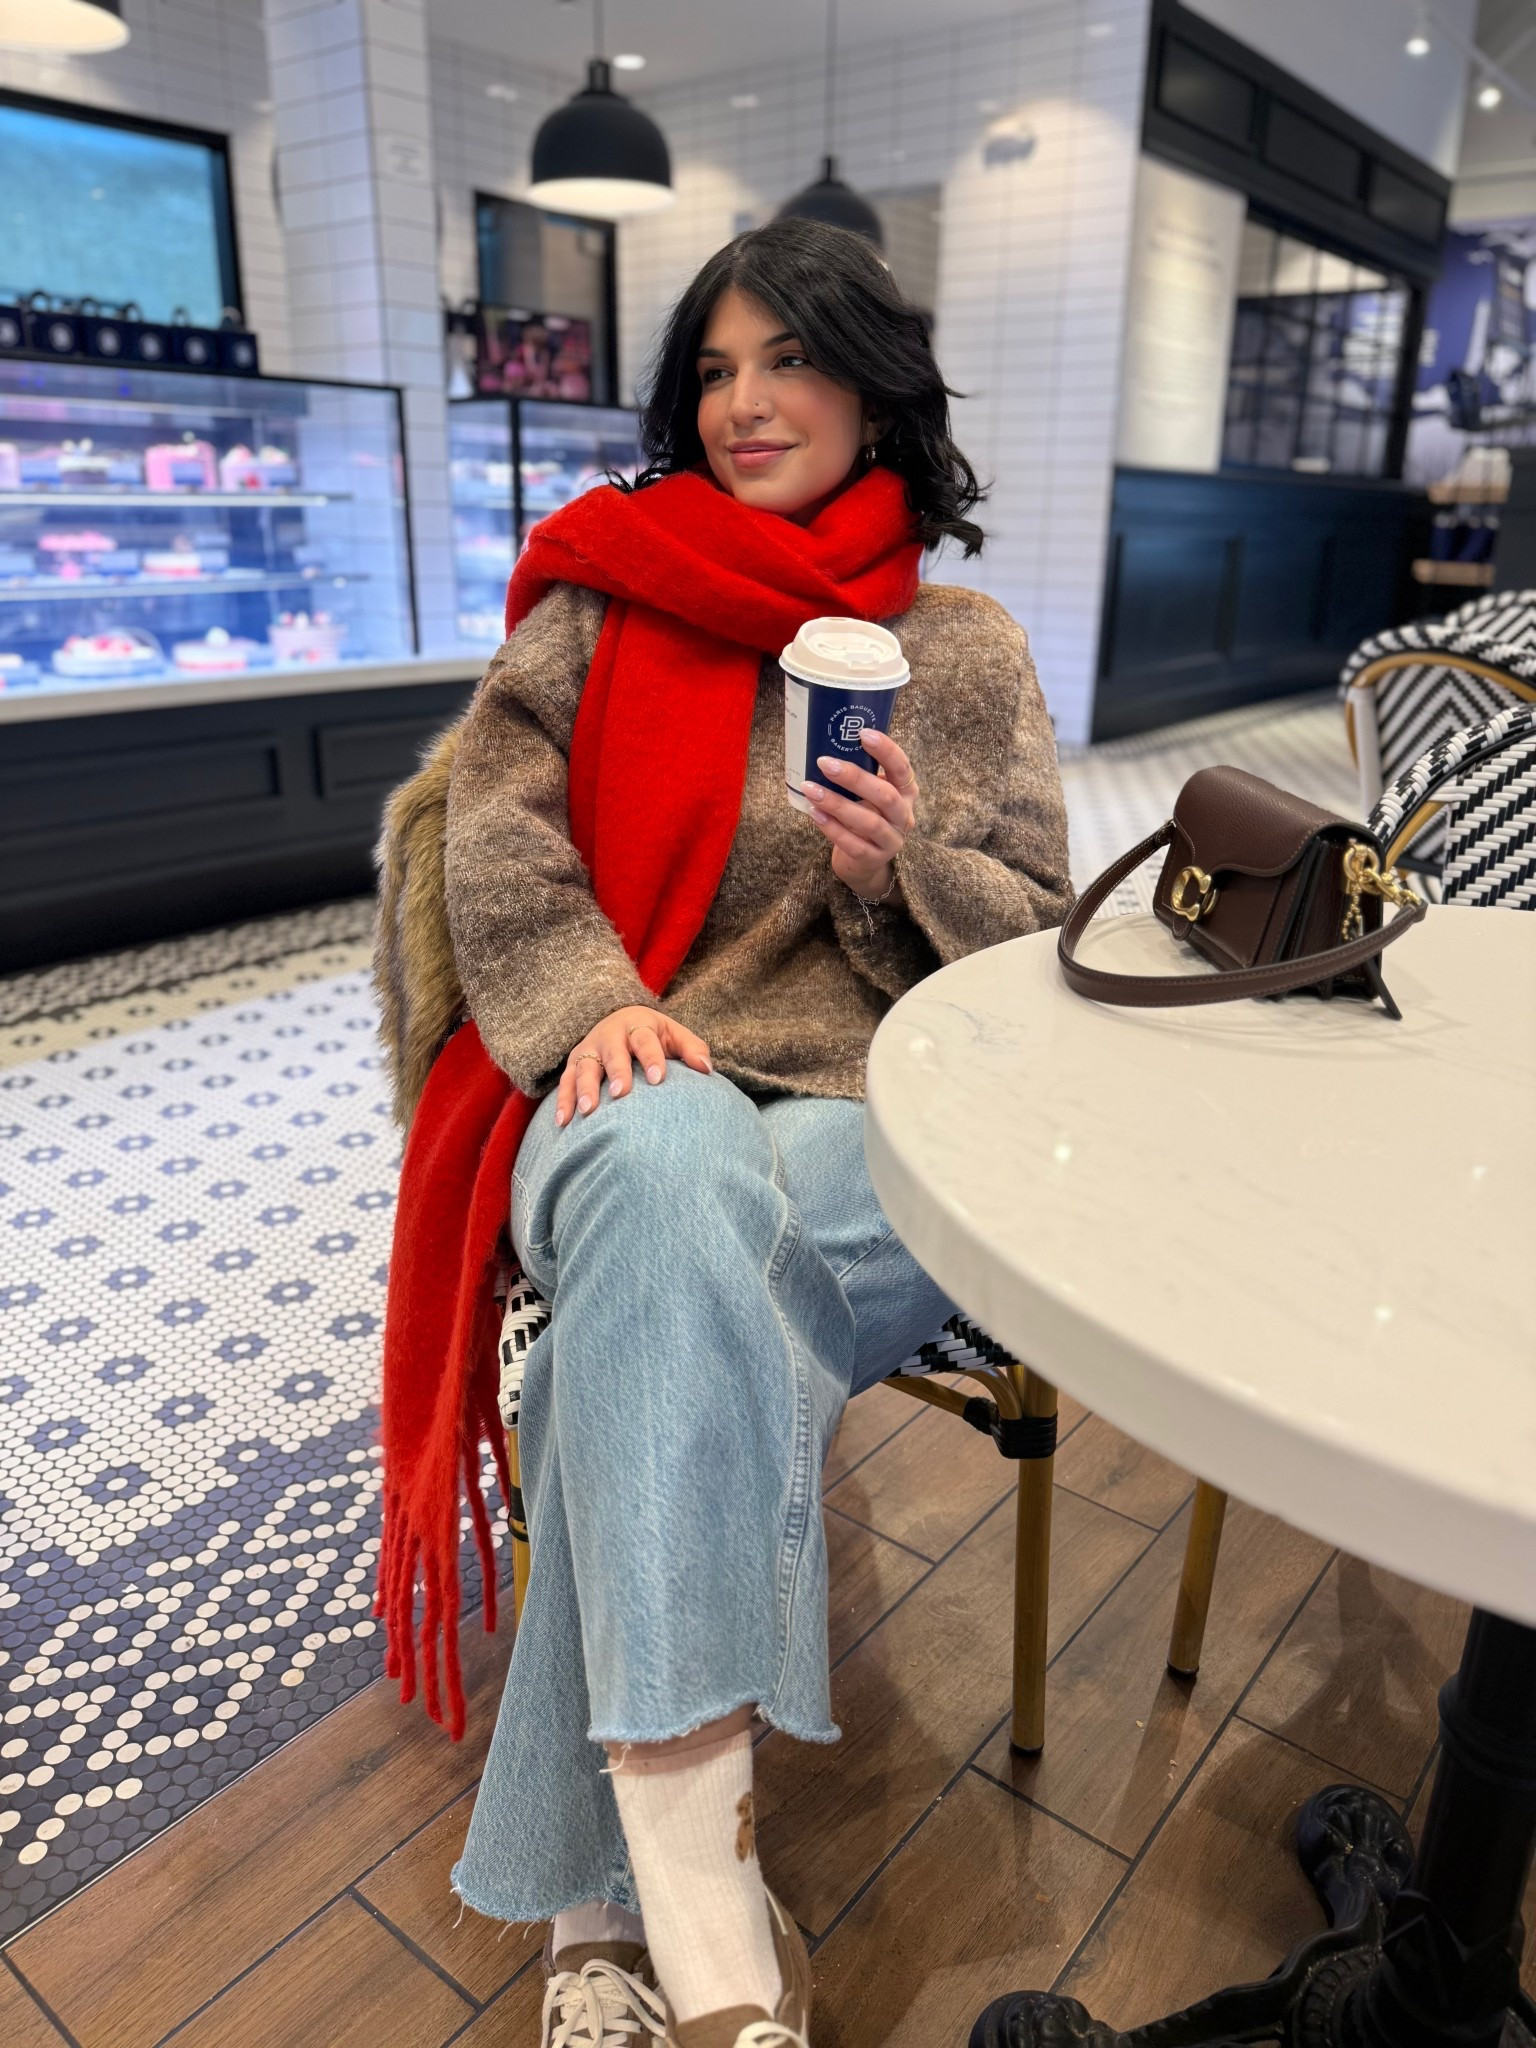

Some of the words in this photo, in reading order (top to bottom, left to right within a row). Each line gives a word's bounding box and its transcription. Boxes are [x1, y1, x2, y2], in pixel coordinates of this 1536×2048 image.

[829, 706, 848, 722] PARIS
[850, 705, 876, 722] BAGUETTE
[830, 738, 854, 752] BAKERY
